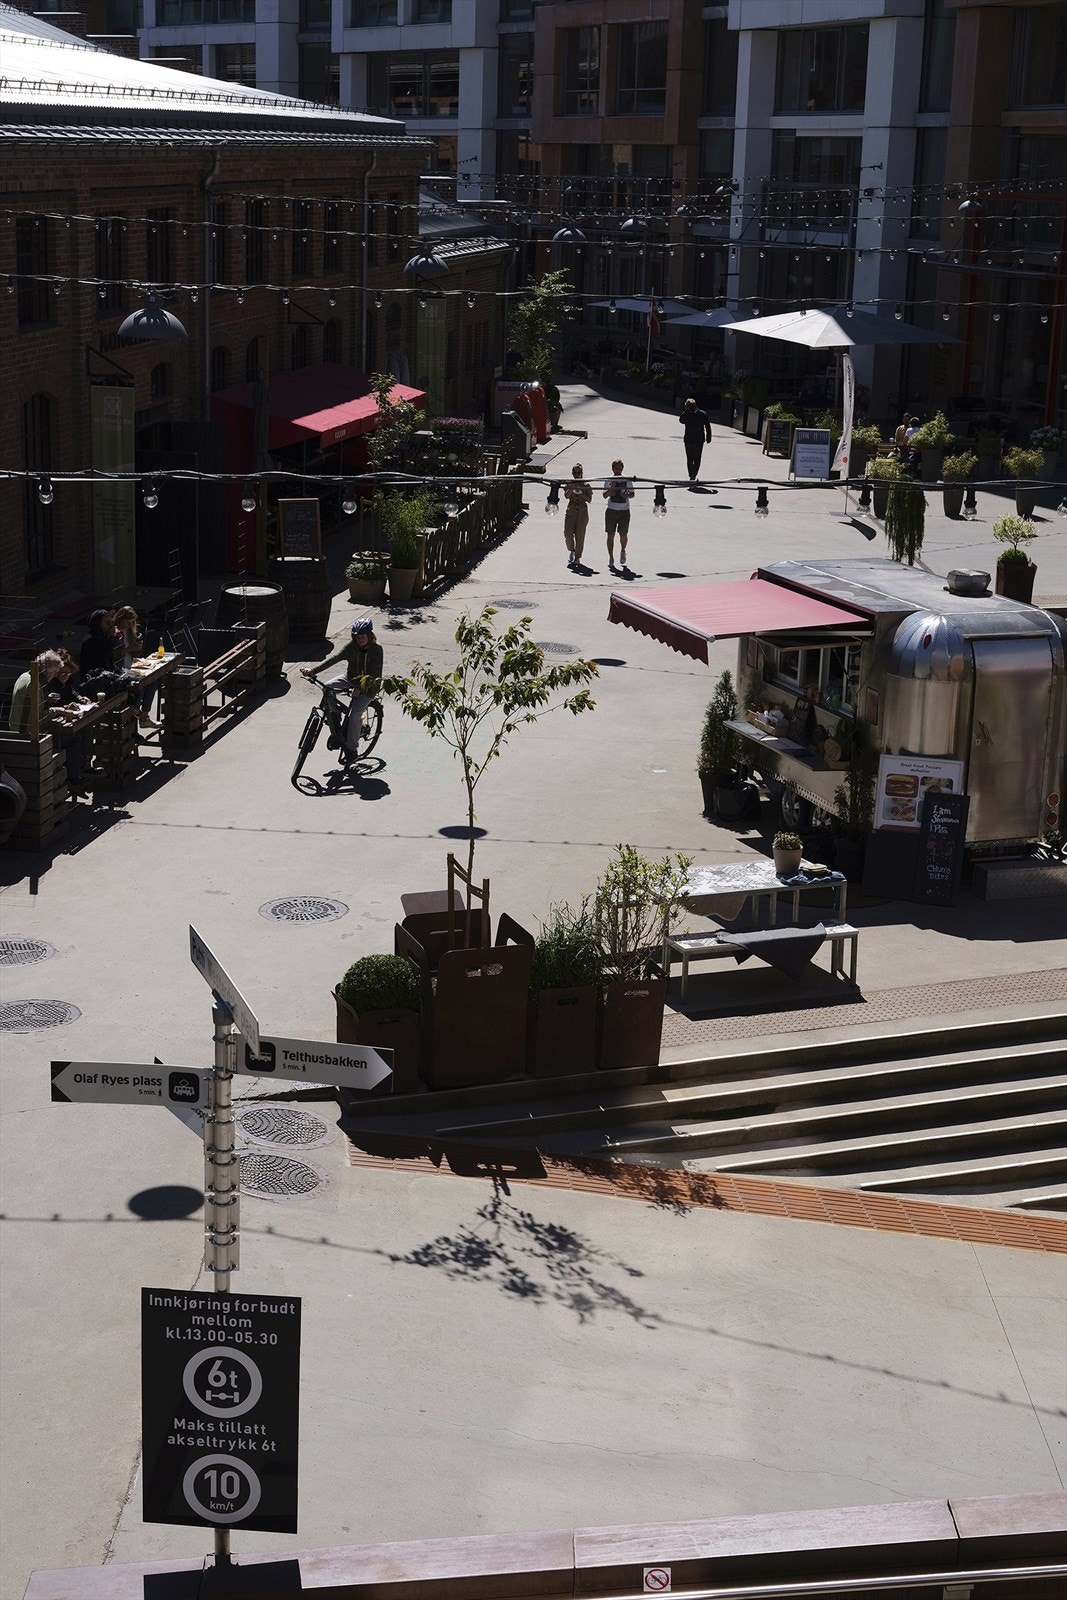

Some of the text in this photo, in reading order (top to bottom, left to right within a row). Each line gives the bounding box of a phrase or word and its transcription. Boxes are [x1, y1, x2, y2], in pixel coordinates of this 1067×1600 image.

[282, 1050, 368, 1070] Telthusbakken
[73, 1073, 163, 1087] Olaf Ryes plass
[149, 1294, 296, 1315] Innkjøring forbudt
[191, 1314, 252, 1328] mellom
[166, 1327, 278, 1345] kl.13.00-05.30
[207, 1359, 239, 1389] 6t
[173, 1418, 267, 1435] Maks tillatt
[167, 1433, 277, 1452] akseltrykk 6t
[204, 1469, 240, 1500] 10
[209, 1501, 234, 1511] km/t
